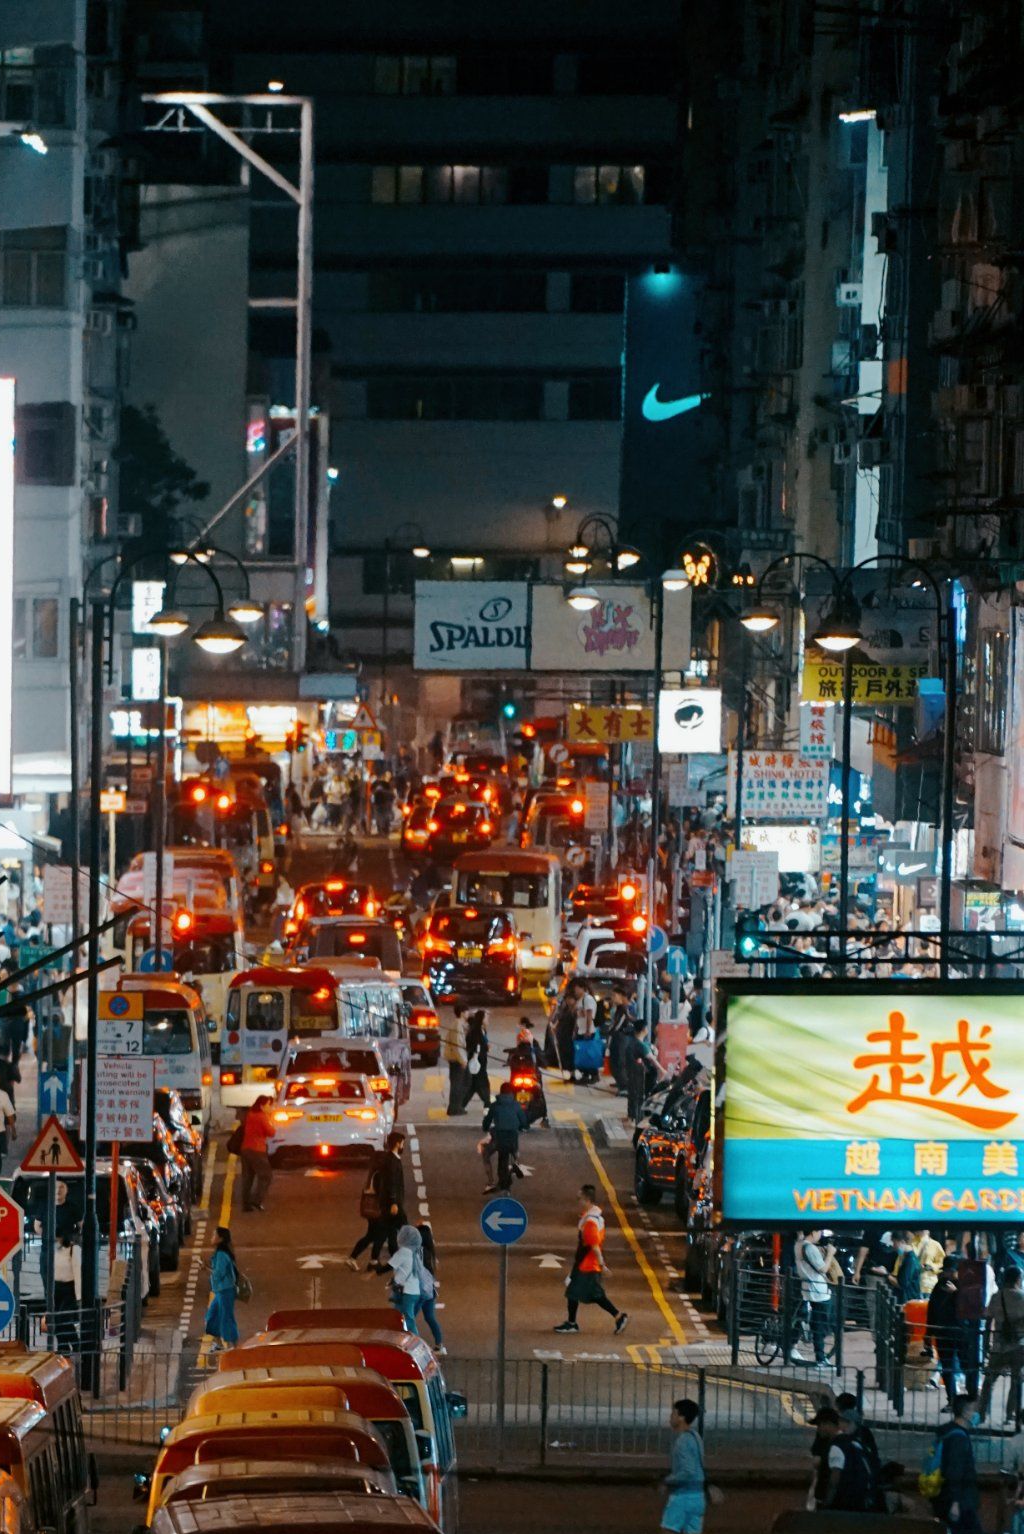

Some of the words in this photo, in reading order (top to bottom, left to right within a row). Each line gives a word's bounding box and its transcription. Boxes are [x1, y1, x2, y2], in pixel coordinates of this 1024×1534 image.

[126, 1021, 134, 1033] 7
[126, 1040, 140, 1052] 12
[103, 1062, 133, 1070] Vehicle
[845, 1010, 1019, 1130] 越
[118, 1088, 151, 1097] warning
[792, 1188, 923, 1212] VIETNAM
